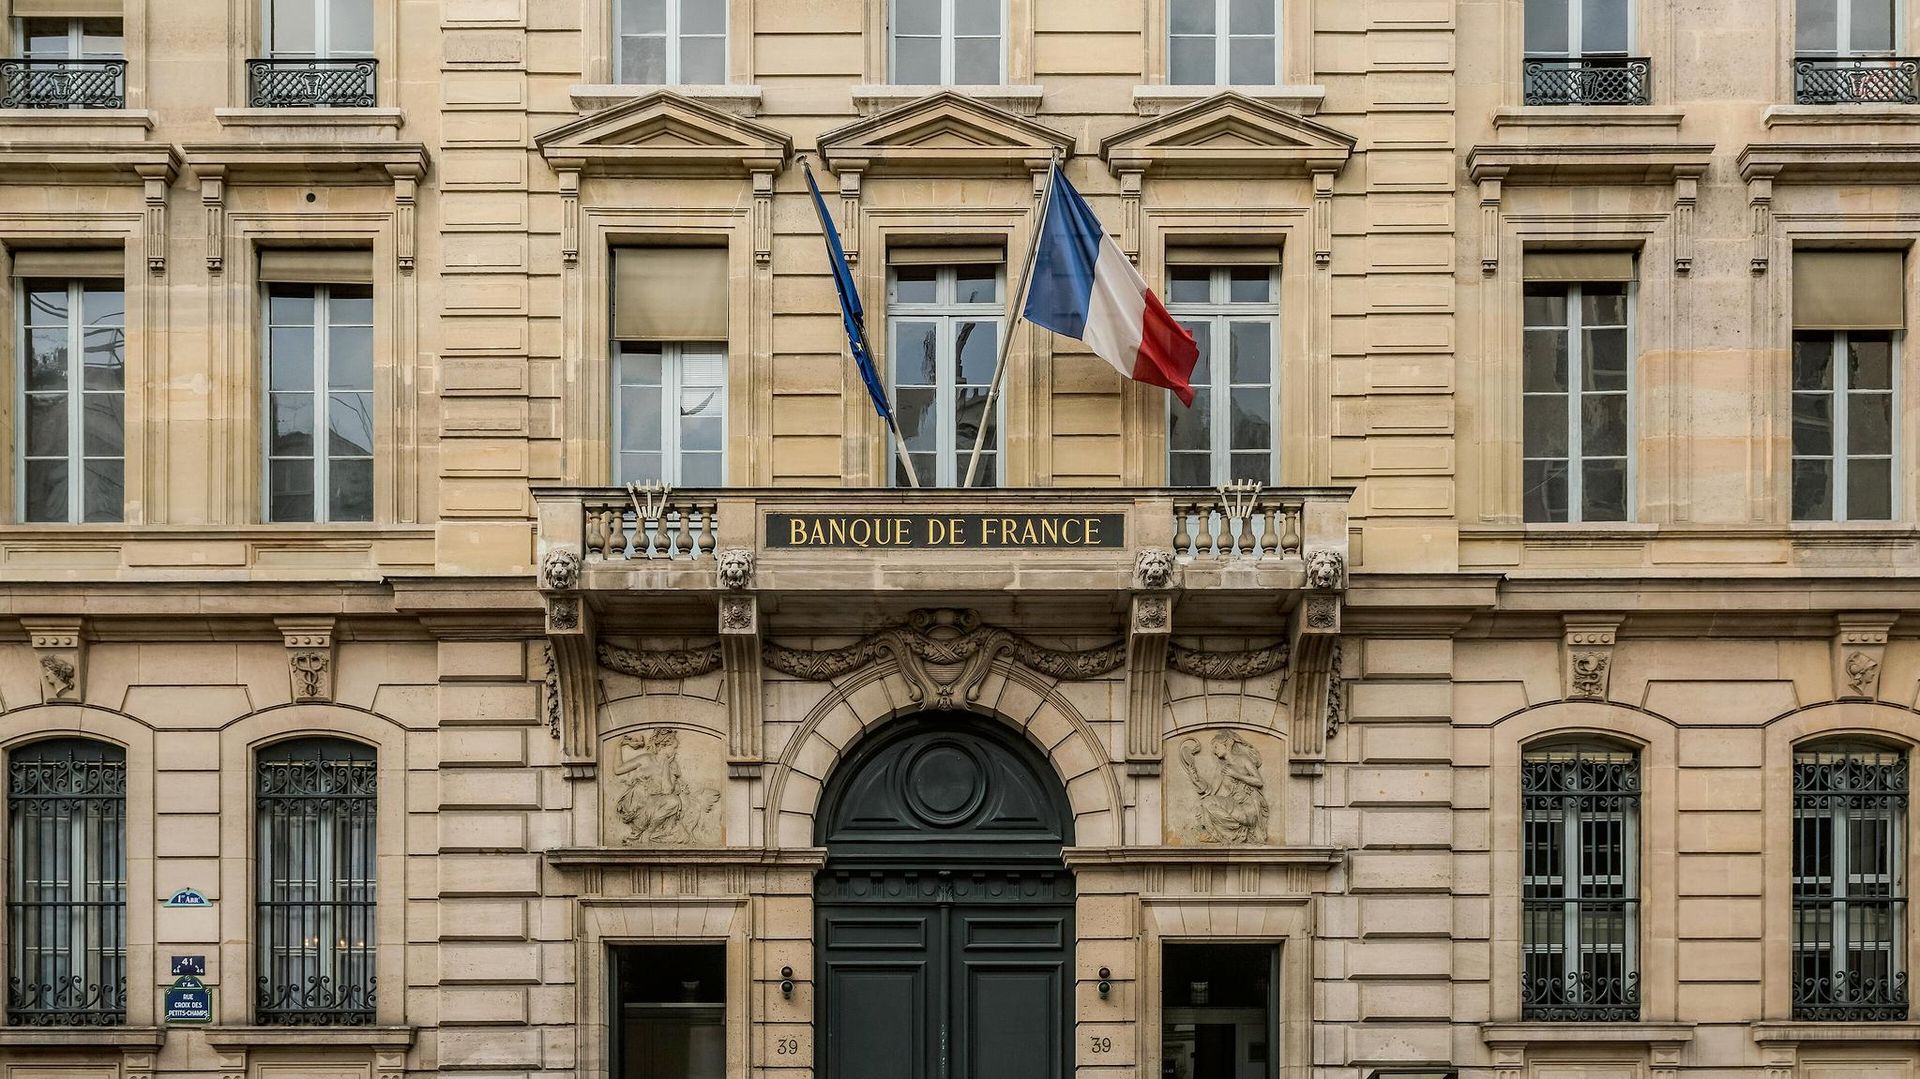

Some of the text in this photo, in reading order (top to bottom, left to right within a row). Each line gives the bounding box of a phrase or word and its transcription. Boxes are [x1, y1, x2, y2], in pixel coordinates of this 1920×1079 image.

[789, 518, 1102, 547] BANQUE DE FRANCE
[181, 957, 193, 965] 41
[777, 1039, 798, 1054] 39
[1091, 1037, 1111, 1053] 39
